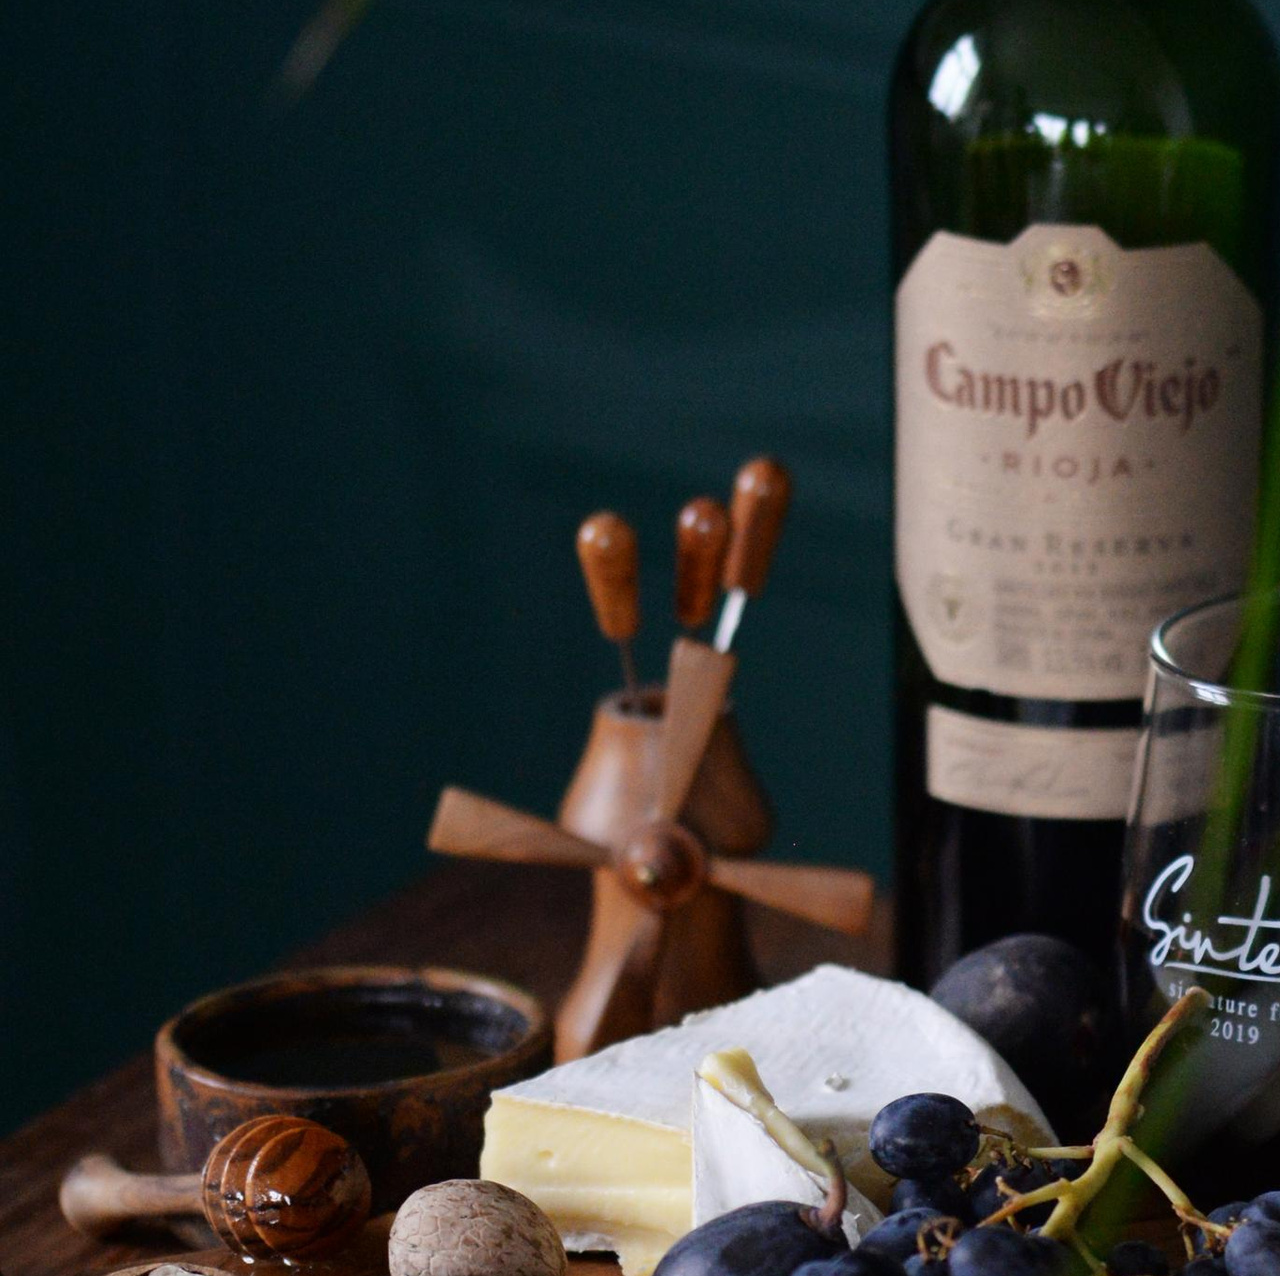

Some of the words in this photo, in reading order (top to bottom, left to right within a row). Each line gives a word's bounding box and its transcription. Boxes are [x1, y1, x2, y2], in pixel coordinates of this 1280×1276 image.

[925, 341, 1087, 437] Campo
[1094, 357, 1221, 435] Viejo
[1001, 451, 1134, 483] RIOJA
[1168, 980, 1258, 1018] siture
[1210, 1018, 1260, 1045] 2019
